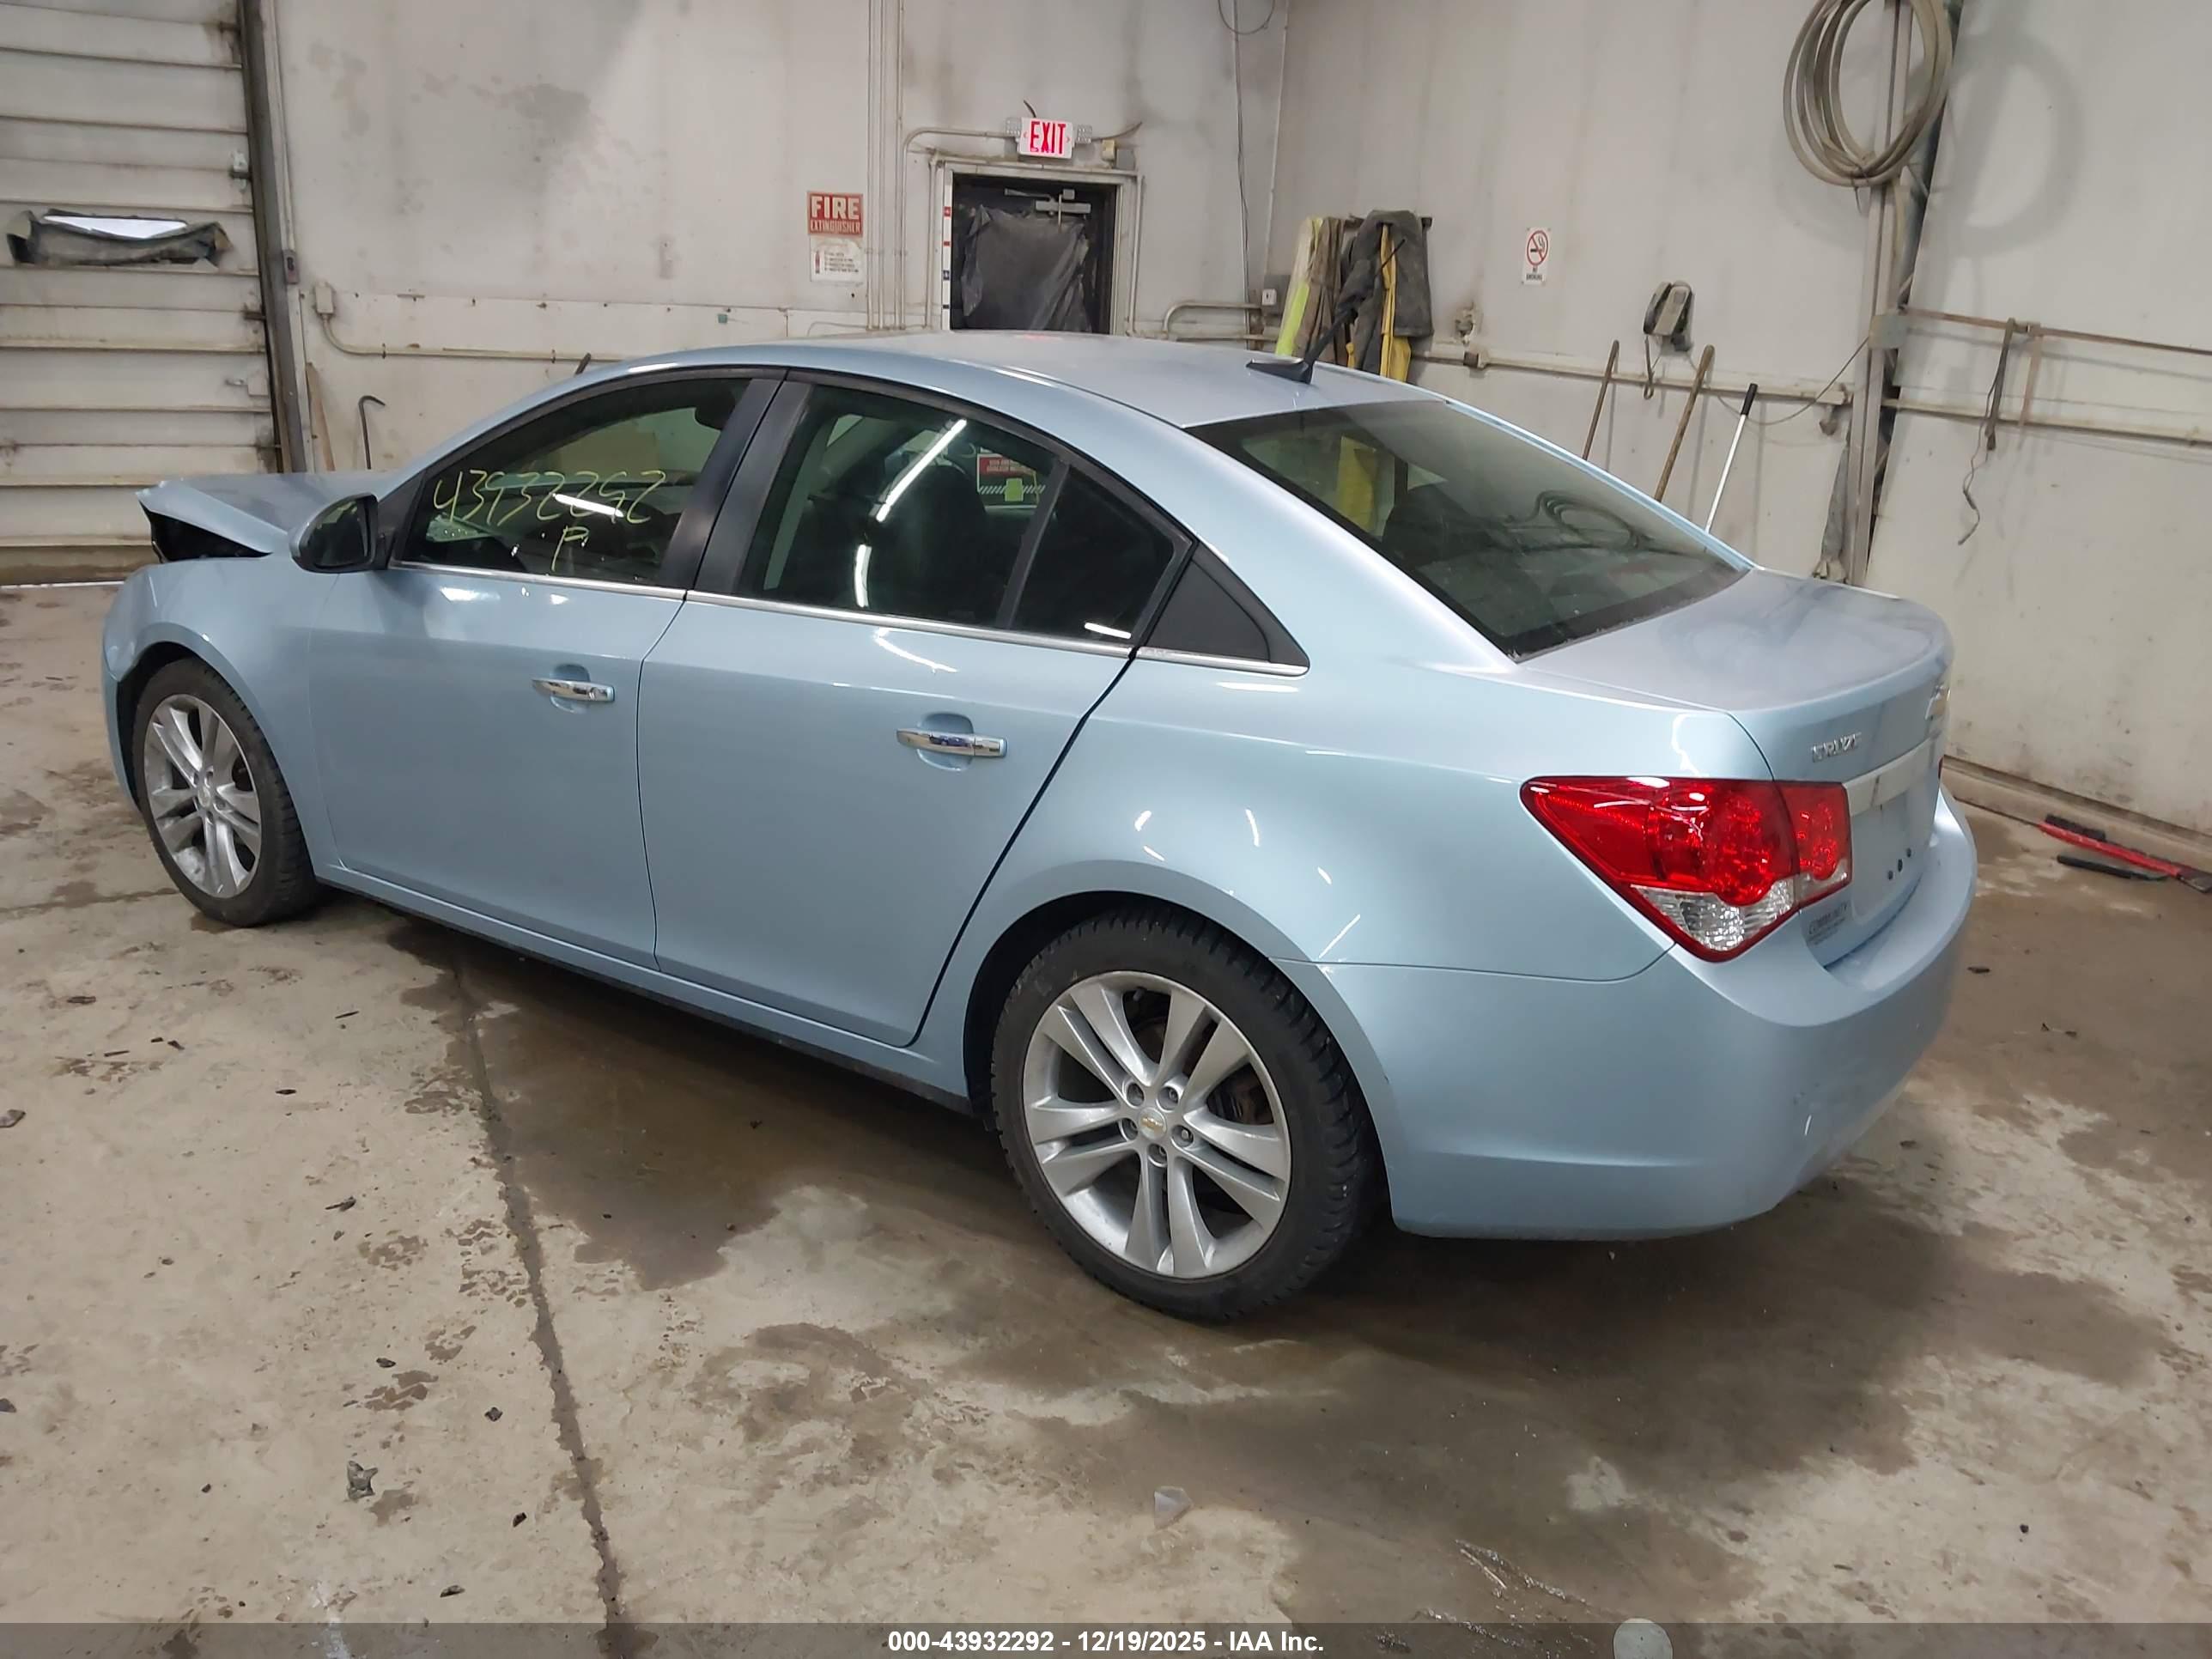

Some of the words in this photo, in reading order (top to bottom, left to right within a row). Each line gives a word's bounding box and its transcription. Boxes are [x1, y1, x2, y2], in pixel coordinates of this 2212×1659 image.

[1030, 121, 1066, 155] EXIT
[811, 195, 860, 221] FIRE
[433, 469, 666, 527] 43932292
